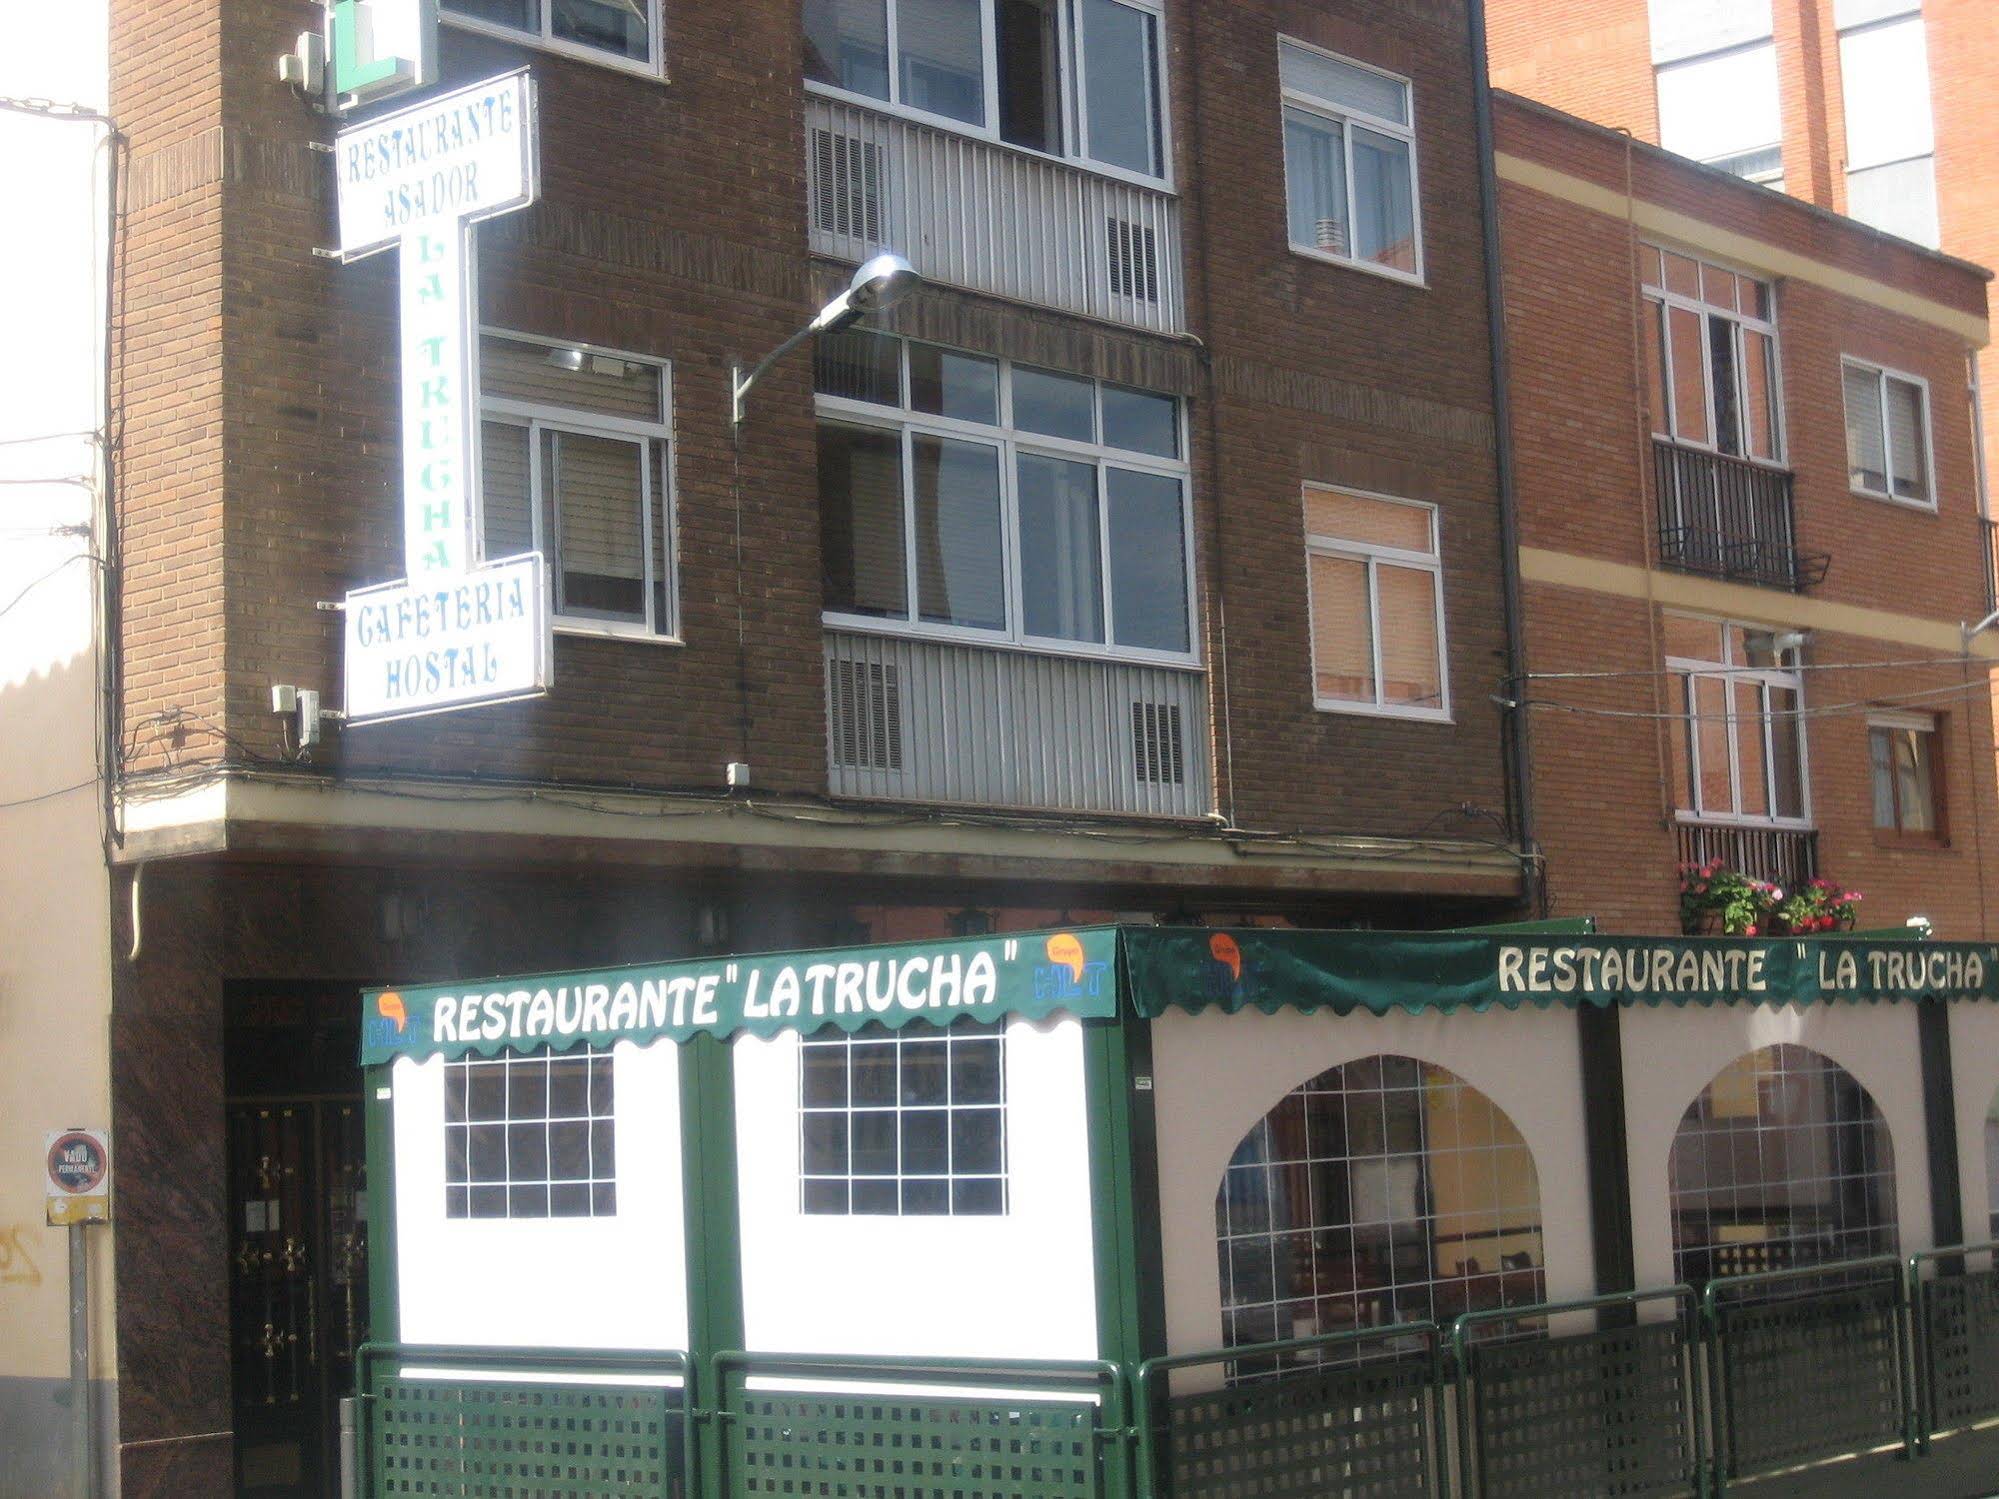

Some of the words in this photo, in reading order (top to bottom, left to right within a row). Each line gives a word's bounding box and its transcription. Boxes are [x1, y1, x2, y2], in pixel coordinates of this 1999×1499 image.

[348, 89, 513, 183] RESTAURANTE
[384, 159, 479, 229] ASADOR
[357, 577, 525, 648] CAFETERIA
[385, 641, 498, 699] HOSTAL
[1498, 946, 1767, 993] RESTAURANTE
[432, 974, 720, 1043] RESTAURANTE
